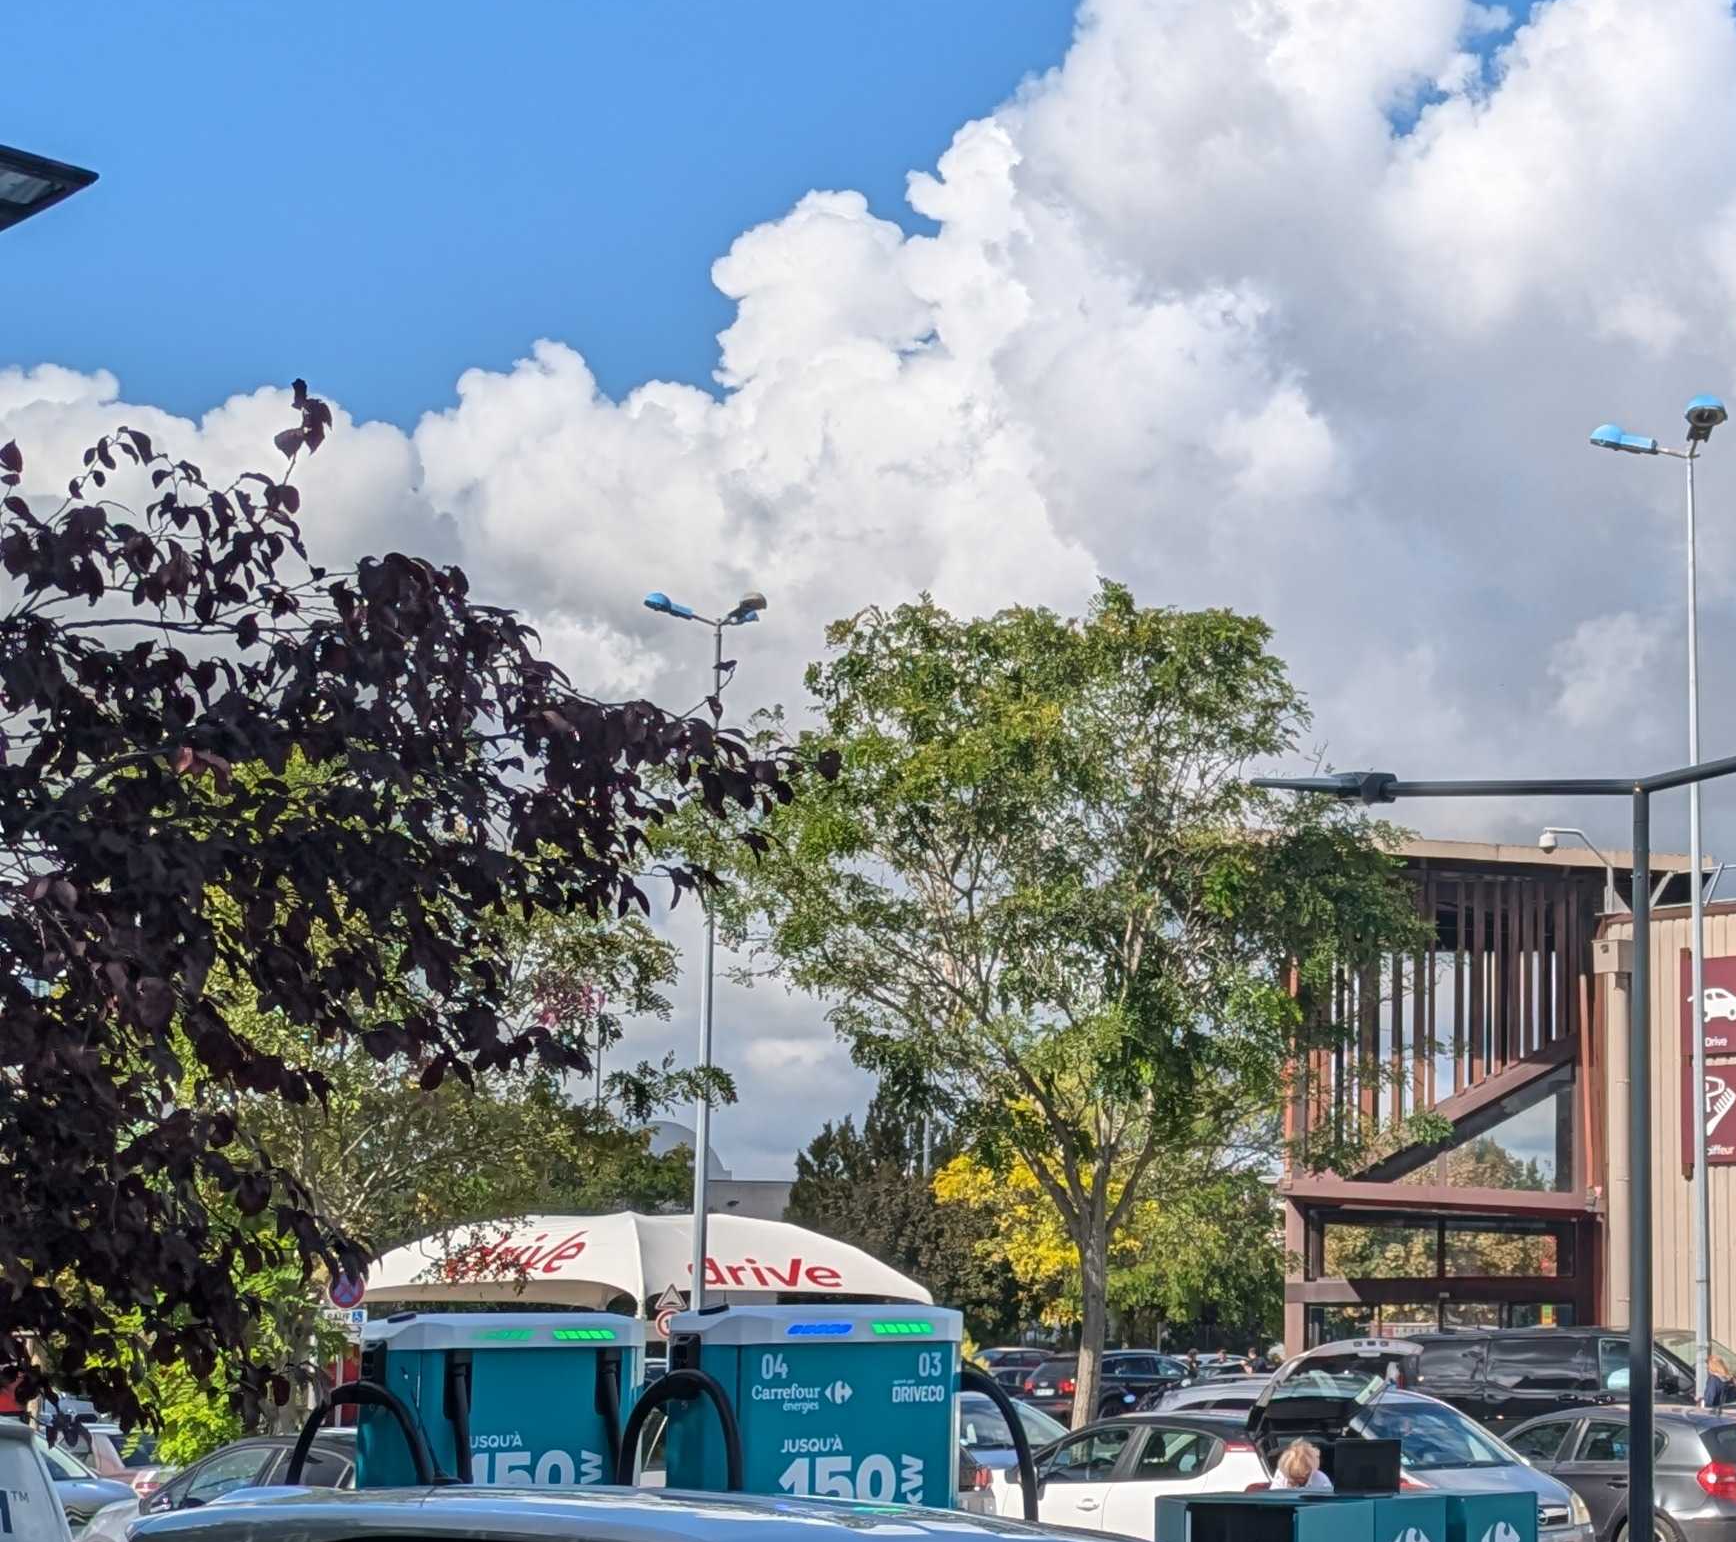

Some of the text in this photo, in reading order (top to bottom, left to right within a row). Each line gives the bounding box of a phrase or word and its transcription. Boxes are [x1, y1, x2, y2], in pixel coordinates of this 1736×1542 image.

[1705, 1037, 1728, 1047] Drive
[761, 1354, 788, 1379] 04
[919, 1352, 942, 1377] 03
[752, 1384, 821, 1400] Carrefour
[892, 1385, 945, 1403] DRIVECO
[783, 1399, 819, 1414] énergies
[470, 1431, 523, 1449] USQU'À
[780, 1435, 843, 1453] JUSQU'À
[472, 1450, 602, 1484] 150 W
[778, 1454, 896, 1503] 150
